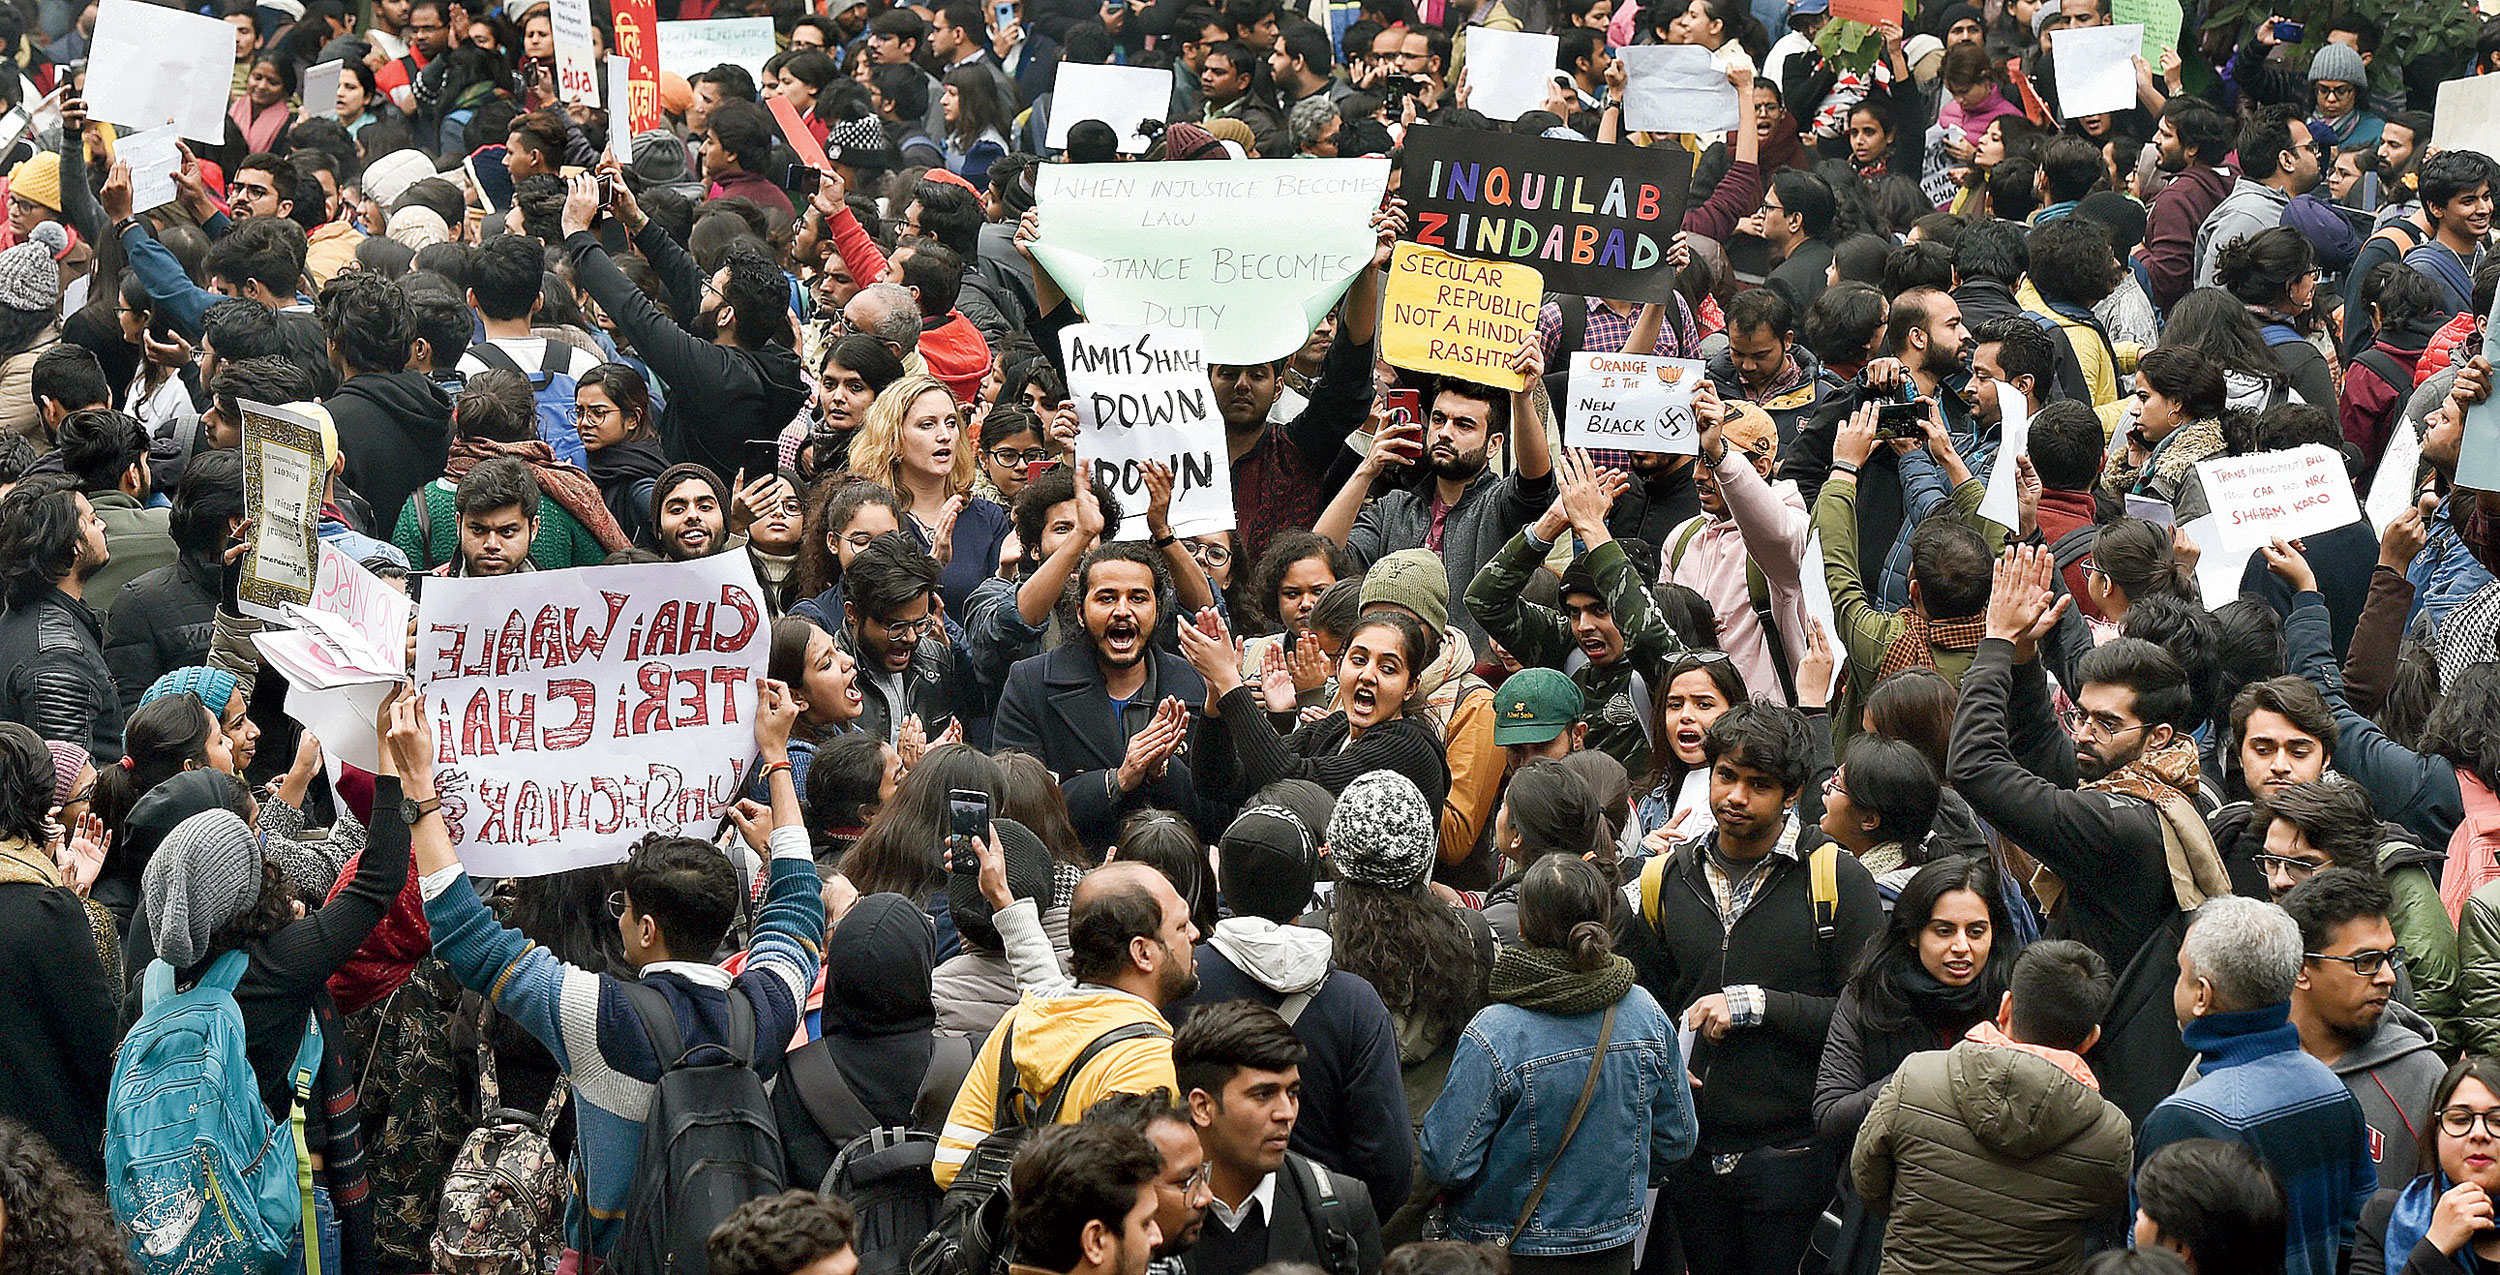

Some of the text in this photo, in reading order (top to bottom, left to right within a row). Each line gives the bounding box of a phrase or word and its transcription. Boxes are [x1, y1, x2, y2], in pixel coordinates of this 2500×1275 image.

[1054, 175, 1384, 199] WHEN INJUSTICE BECOMES
[1428, 160, 1661, 221] INQUILAB
[1142, 211, 1195, 227] LAW
[1416, 212, 1660, 270] ZINDABAD
[1211, 247, 1352, 284] BECOMES
[1400, 253, 1503, 288] SECULAR
[1142, 300, 1226, 330] DUTY
[1394, 303, 1441, 328] NOT
[1442, 315, 1460, 334] A
[1436, 284, 1536, 324] REPUBLIC
[1072, 333, 1204, 375] AMIT SHAH
[1428, 339, 1513, 370] RASHTR
[1590, 356, 1648, 374] ORANGE
[1622, 378, 1640, 389] THE
[1090, 388, 1207, 430] DOWN
[1579, 398, 1616, 412] NEW
[1586, 415, 1646, 433] BLACK
[273, 466, 299, 482] BOYCOTT
[1094, 451, 1213, 496] DON
[2212, 468, 2247, 484] TRANS
[2253, 486, 2275, 499] CAA
[2232, 494, 2331, 525] SHARAM KARO
[320, 552, 371, 624] NRC
